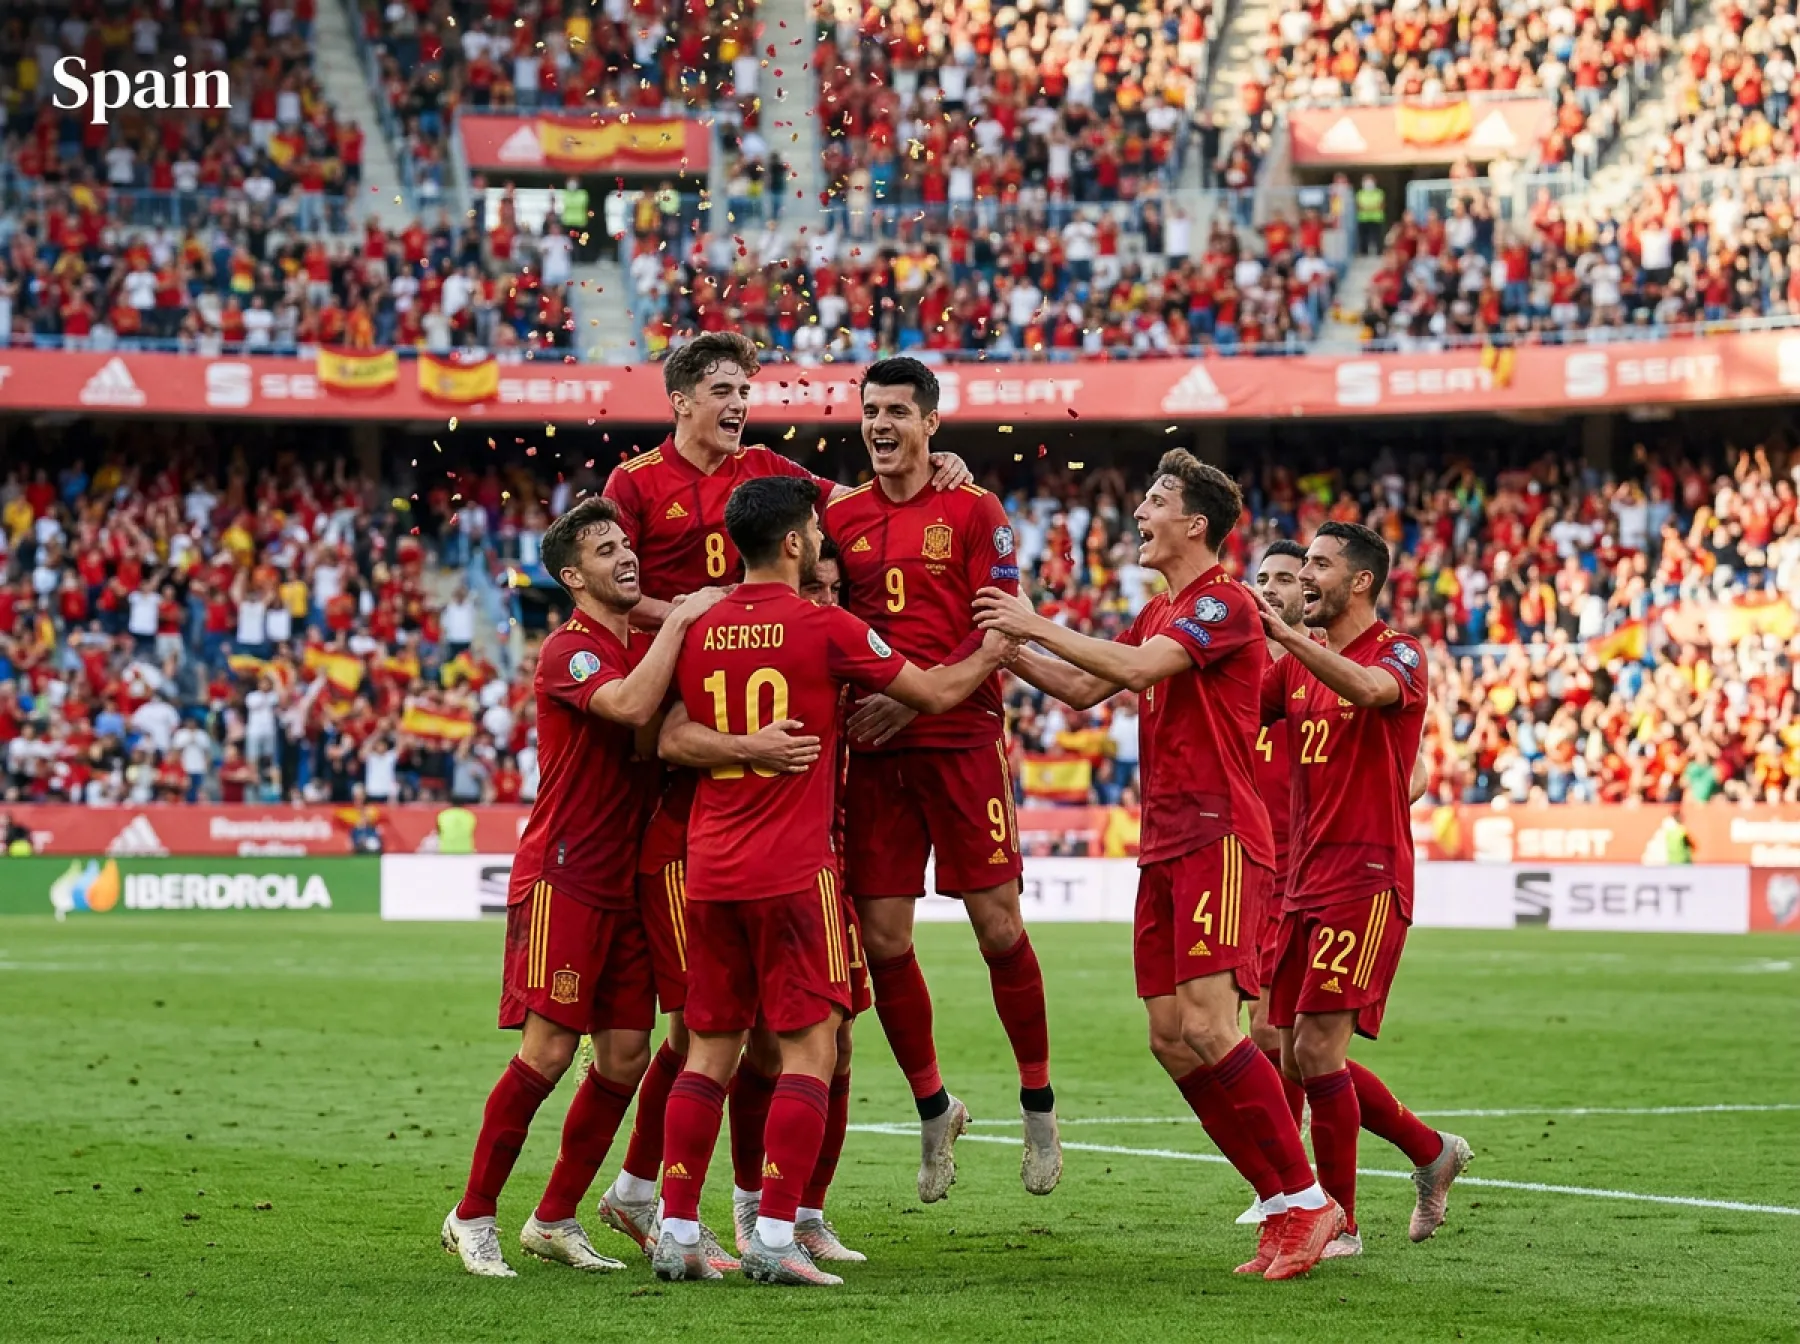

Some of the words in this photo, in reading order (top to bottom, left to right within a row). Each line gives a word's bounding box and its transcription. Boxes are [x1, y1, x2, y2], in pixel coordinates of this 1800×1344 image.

[1616, 354, 1721, 386] SEAT
[498, 379, 612, 403] SEAT
[966, 379, 1084, 403] SEAT
[705, 532, 727, 579] 8
[885, 567, 906, 613] 9
[703, 623, 784, 651] ASERSIO
[703, 667, 788, 780] 10
[1300, 719, 1330, 764] 22
[1255, 725, 1273, 762] 4
[987, 797, 1006, 842] 9
[1517, 828, 1613, 857] SEAT
[124, 873, 332, 909] IBERDROLA
[1568, 884, 1692, 915] SEAT
[1192, 890, 1213, 935] 4
[1312, 926, 1357, 975] 22
